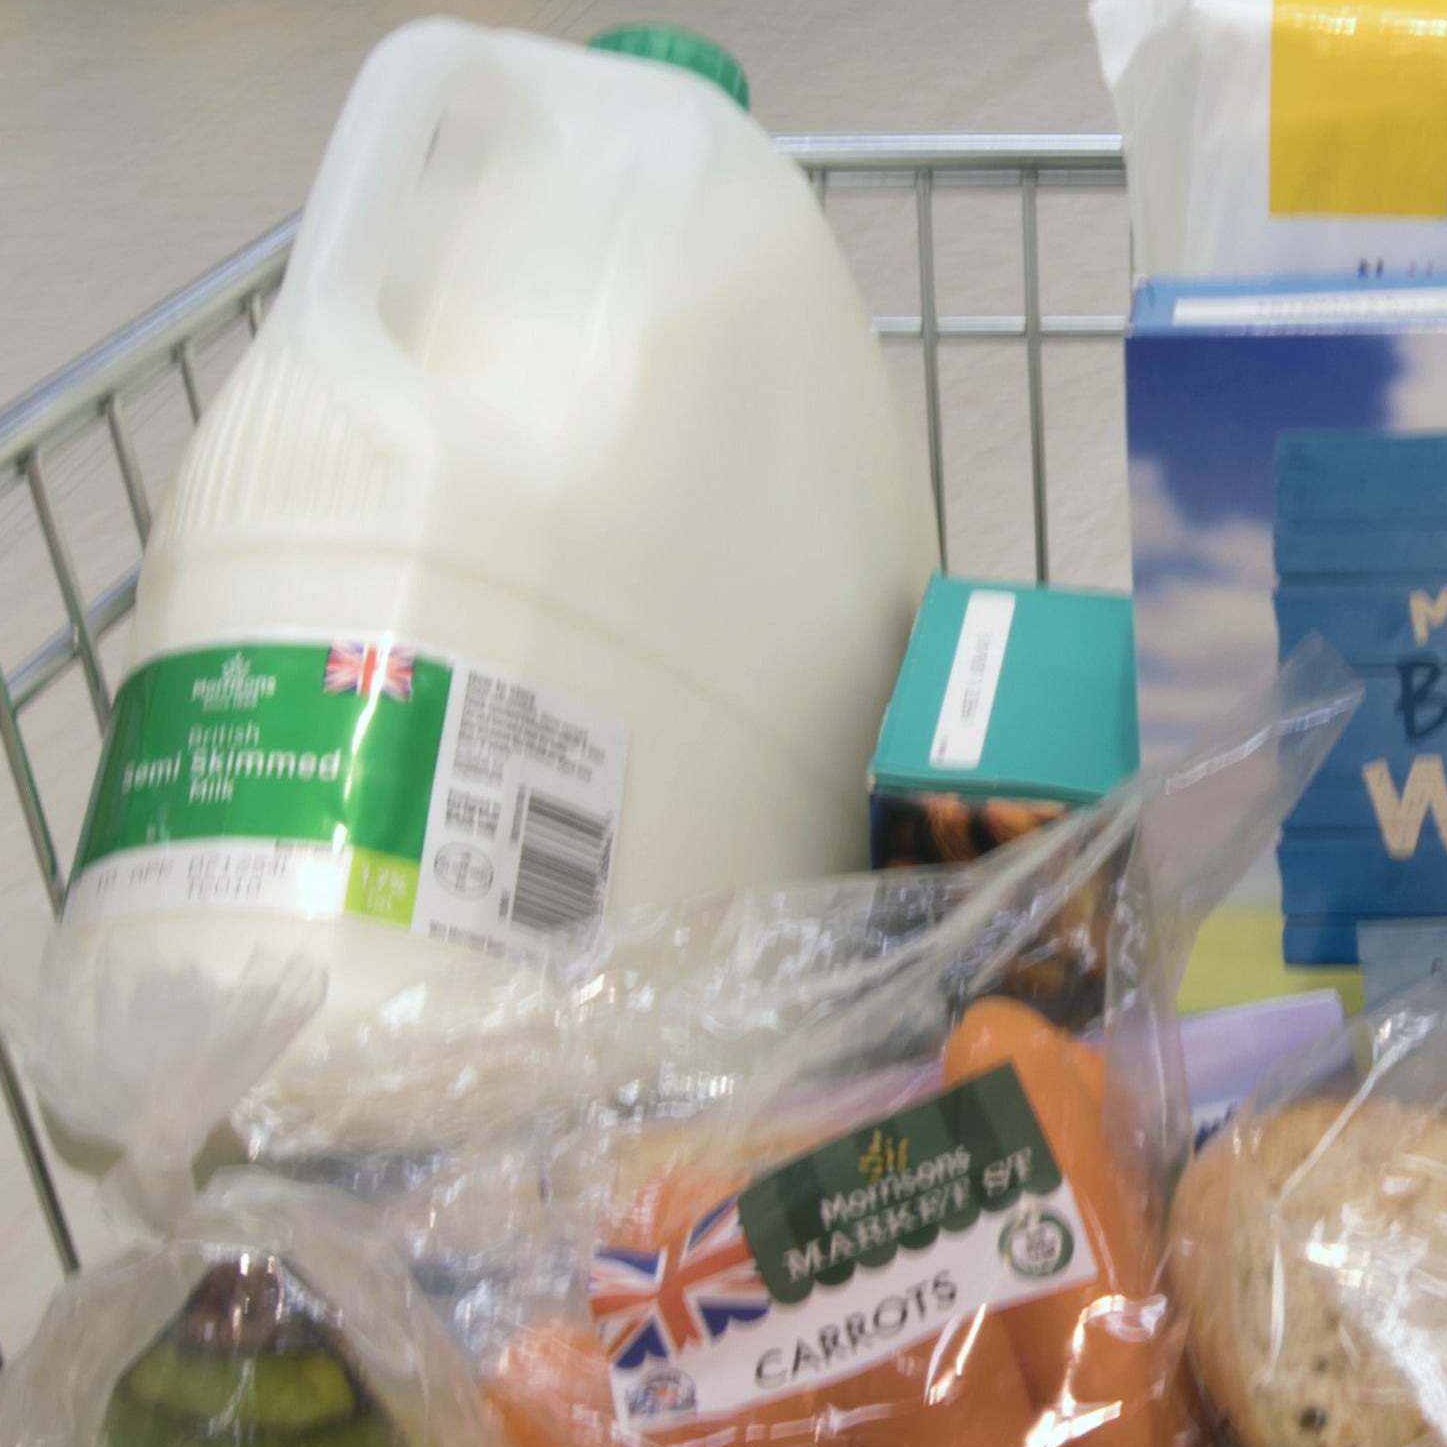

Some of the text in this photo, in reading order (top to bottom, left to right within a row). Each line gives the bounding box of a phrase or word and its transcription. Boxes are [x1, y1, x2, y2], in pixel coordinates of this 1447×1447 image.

[122, 748, 342, 796] semi skimmed
[782, 1175, 971, 1285] MARKET
[820, 1143, 972, 1233] Morrisons
[755, 1270, 958, 1391] CARROTS
